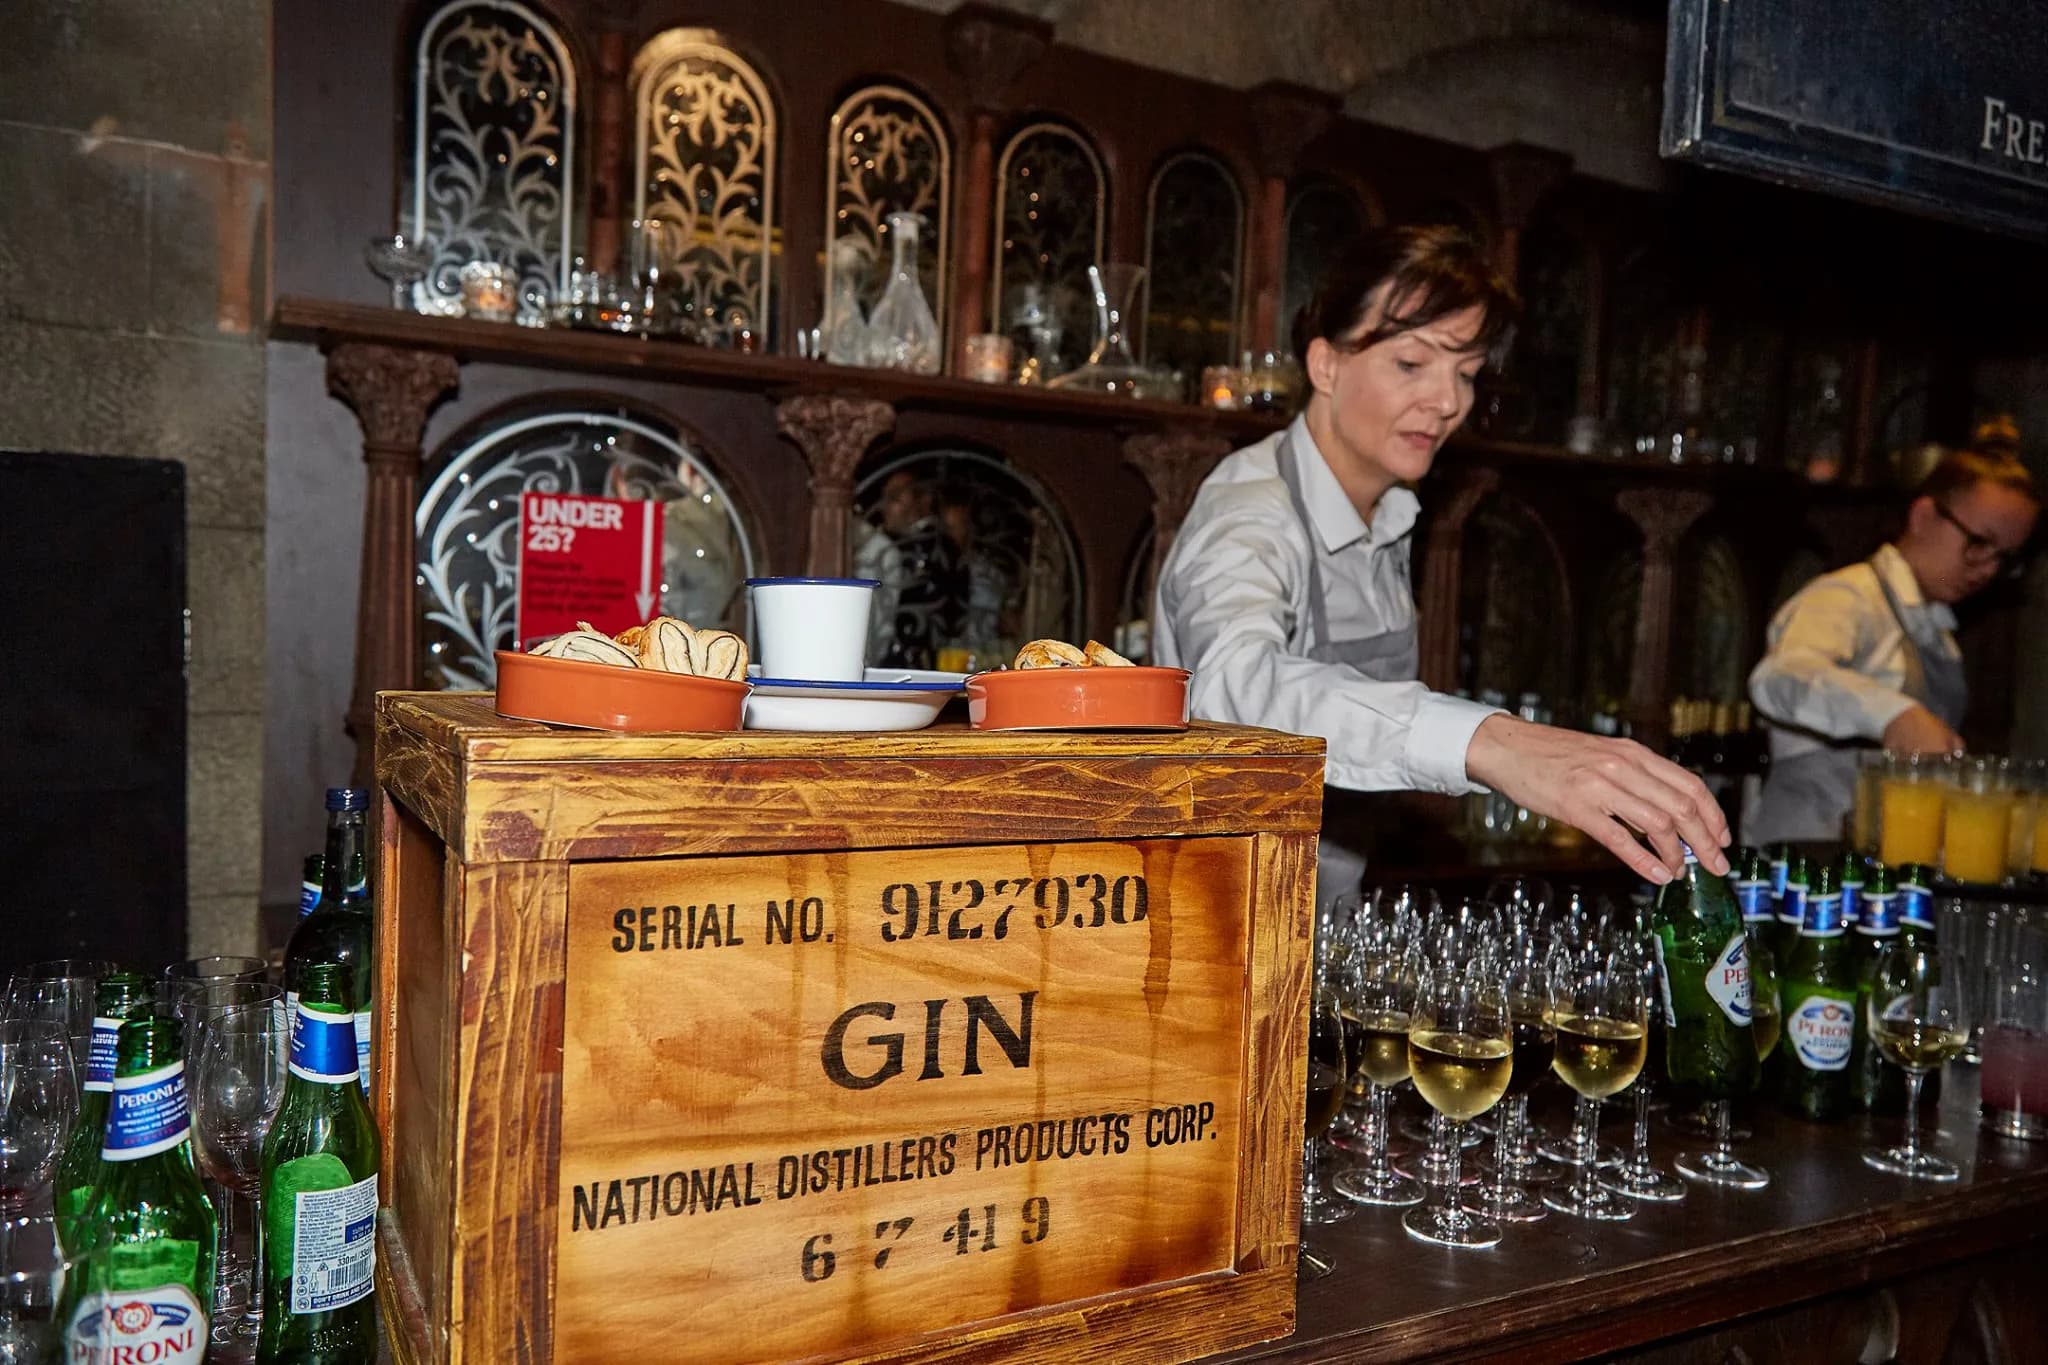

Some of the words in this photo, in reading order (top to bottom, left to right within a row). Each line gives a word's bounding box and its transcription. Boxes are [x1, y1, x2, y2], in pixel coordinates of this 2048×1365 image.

[1981, 96, 2048, 164] FRE
[527, 525, 576, 552] 25?
[528, 497, 623, 530] UNDER
[612, 904, 743, 952] SERIAL
[765, 897, 834, 944] NO.
[881, 873, 1150, 943] 9127930
[821, 990, 1039, 1091] GIN
[118, 1083, 173, 1109] PERONI
[573, 1162, 762, 1232] NATIONAL
[777, 1134, 957, 1200] DISTILLERS
[975, 1112, 1134, 1171] PRODUCTS
[1145, 1101, 1216, 1148] CORP.
